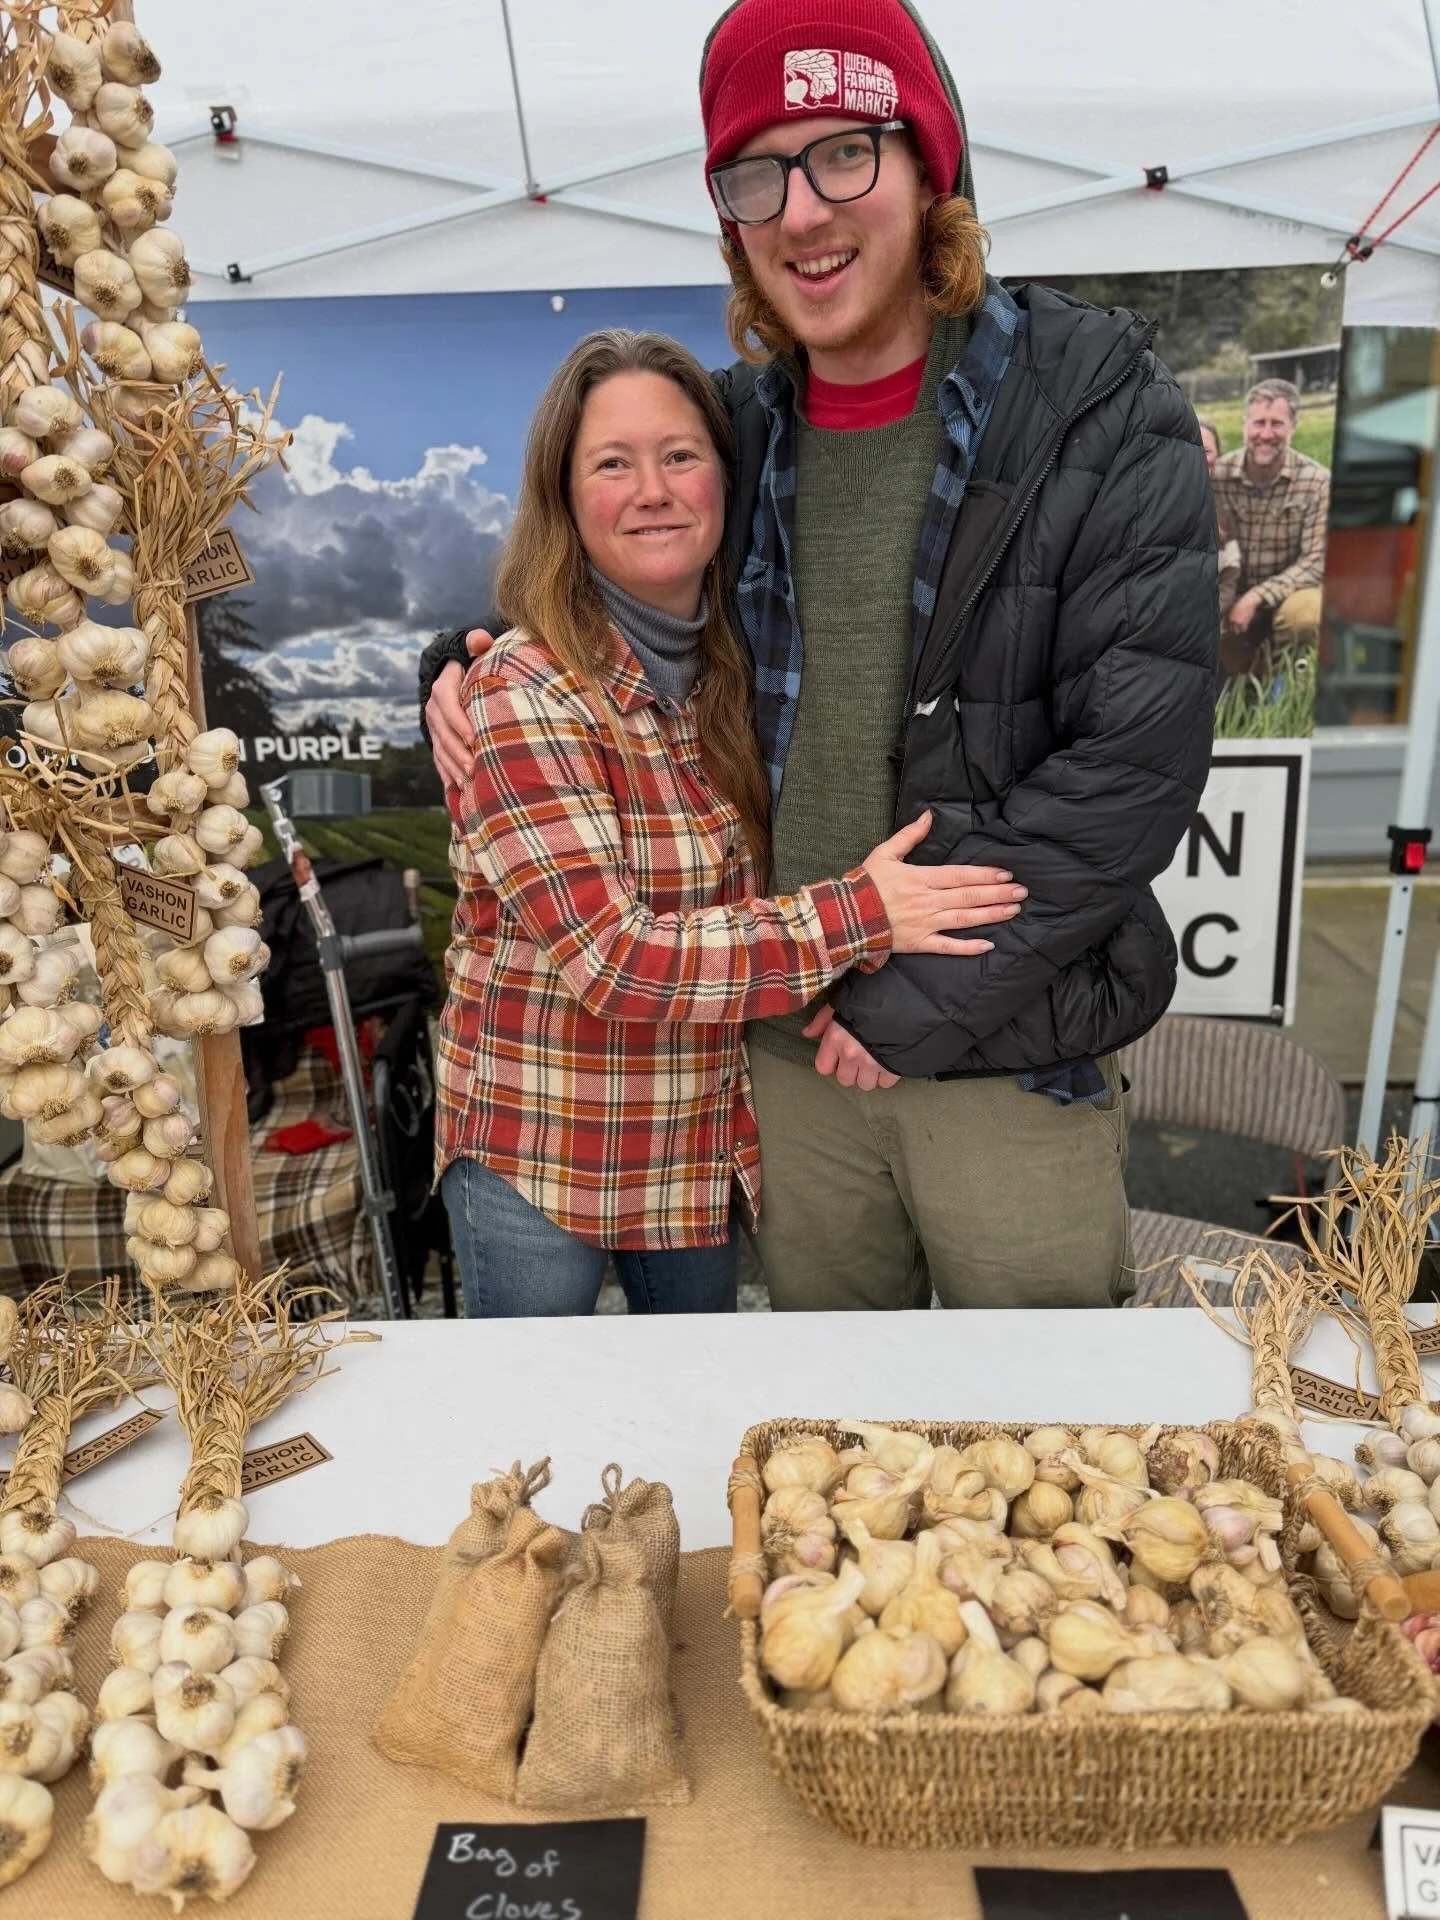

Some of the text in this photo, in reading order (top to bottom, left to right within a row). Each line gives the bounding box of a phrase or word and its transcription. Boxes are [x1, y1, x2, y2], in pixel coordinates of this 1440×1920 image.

[844, 52, 873, 74] QUEEN
[844, 72, 899, 97] FARMERS
[844, 88, 899, 119] MARKET
[186, 562, 238, 588] ARLIC
[254, 735, 383, 762] PURPLE
[127, 877, 187, 911] VASHON
[127, 896, 186, 929] GARLIC
[1292, 1386, 1366, 1417] GARLIC
[67, 1417, 144, 1463] VASHON
[242, 1442, 306, 1471] ASHON
[447, 1832, 561, 1877] Bag of
[465, 1892, 583, 1920] Cloves
